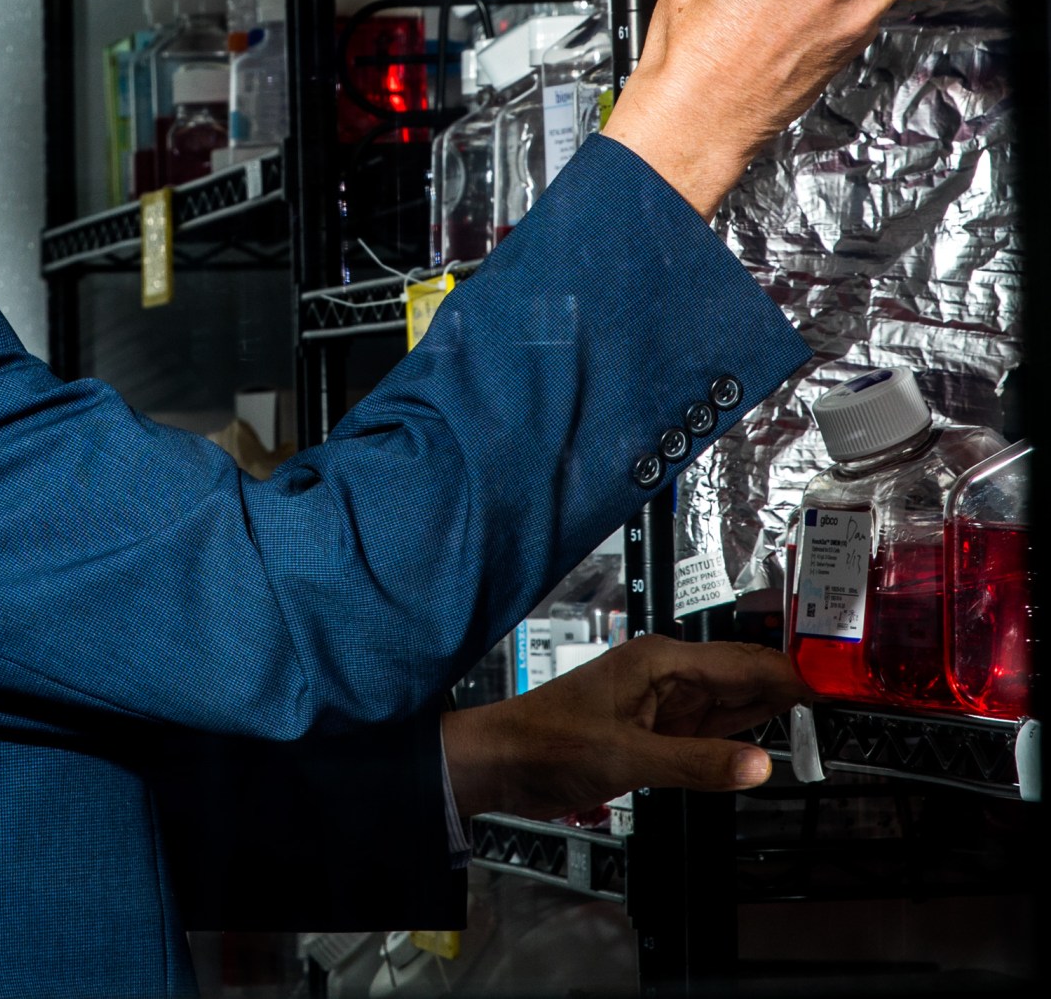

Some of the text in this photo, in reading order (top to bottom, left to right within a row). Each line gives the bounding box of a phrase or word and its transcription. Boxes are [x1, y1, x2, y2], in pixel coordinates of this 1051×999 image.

[618, 26, 629, 40] 61
[619, 75, 629, 89] 6
[820, 514, 839, 528] gibco
[630, 529, 642, 542] 51
[678, 557, 723, 577] INSTITUTE
[632, 579, 645, 593] 50
[690, 585, 700, 595] CA
[701, 579, 726, 592] 92037
[686, 590, 721, 606] 453-4100
